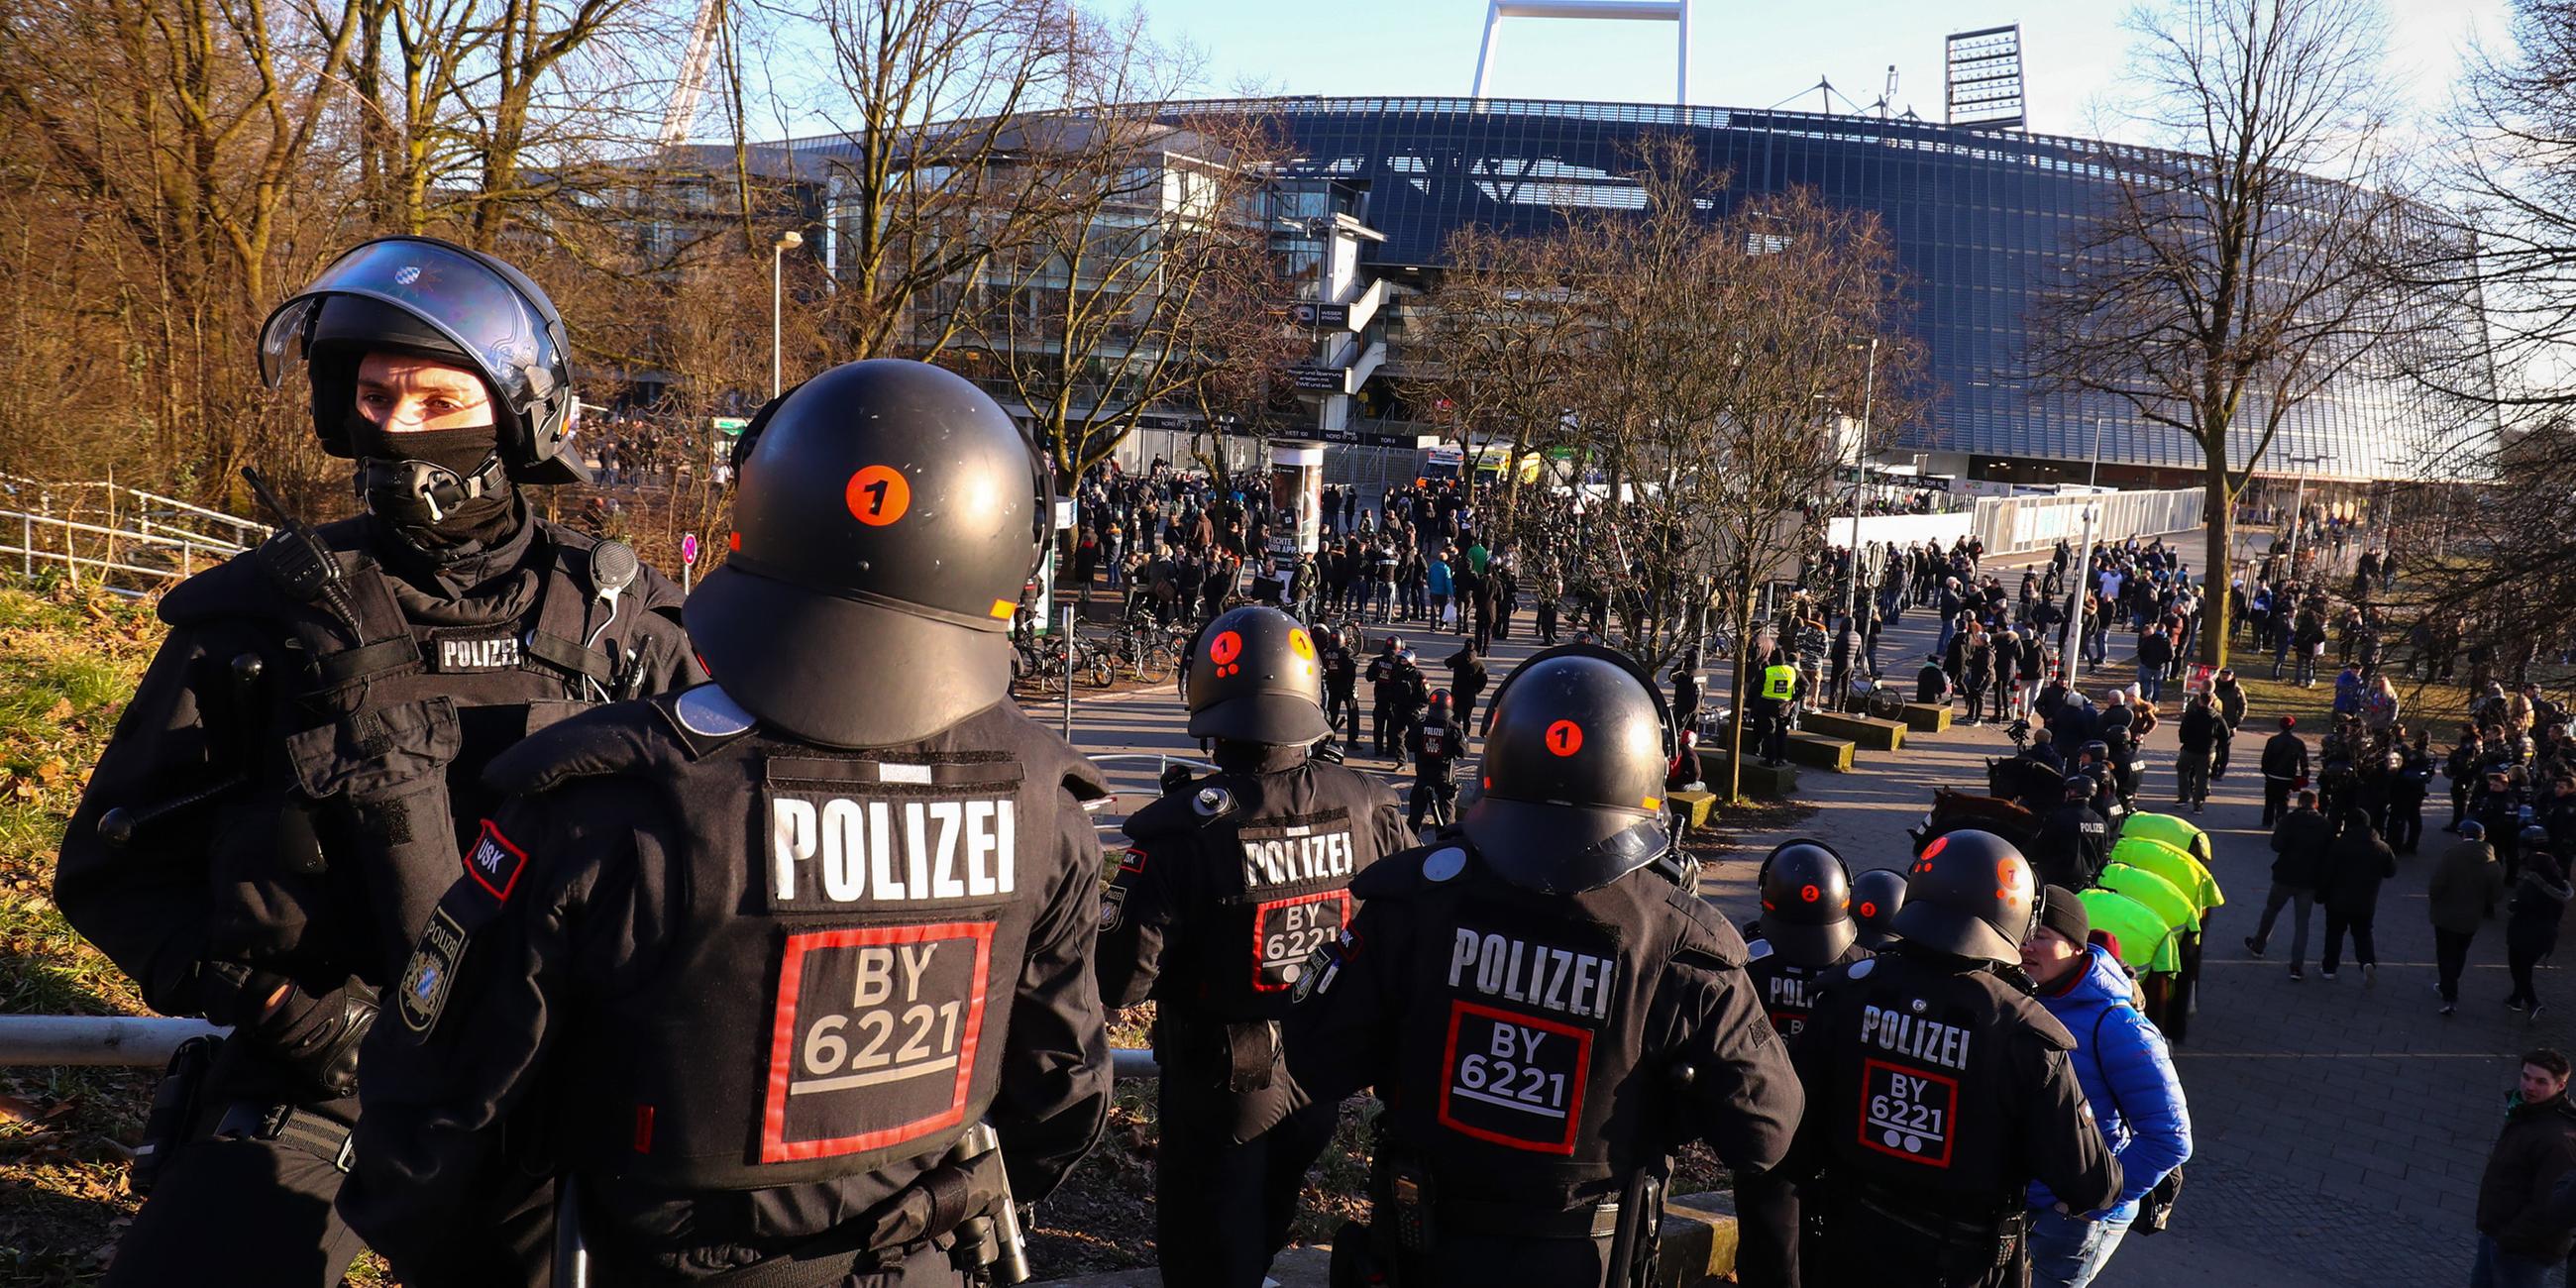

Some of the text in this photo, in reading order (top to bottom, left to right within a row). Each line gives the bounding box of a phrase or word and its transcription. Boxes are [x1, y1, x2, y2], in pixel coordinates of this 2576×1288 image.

[864, 480, 888, 516] 1
[444, 638, 519, 667] POLIZEI
[1423, 726, 1444, 736] POLIZEI
[1555, 726, 1568, 748] 1
[2080, 822, 2105, 833] POLIZEI
[477, 838, 505, 874] USK
[774, 799, 1015, 902] POLIZEI
[1245, 831, 1353, 887] POLIZEI
[1286, 903, 1322, 931] BY
[1266, 926, 1337, 960] 6221
[854, 943, 938, 1009] BY
[1449, 927, 1613, 1020] POLIZEI
[804, 1001, 960, 1074] 6221
[1491, 1021, 1547, 1064] BY
[1861, 1005, 1971, 1071] POLIZEI
[1460, 1053, 1564, 1108] 6221
[1890, 1073, 1928, 1103] BY
[1872, 1095, 1942, 1133] 6221
